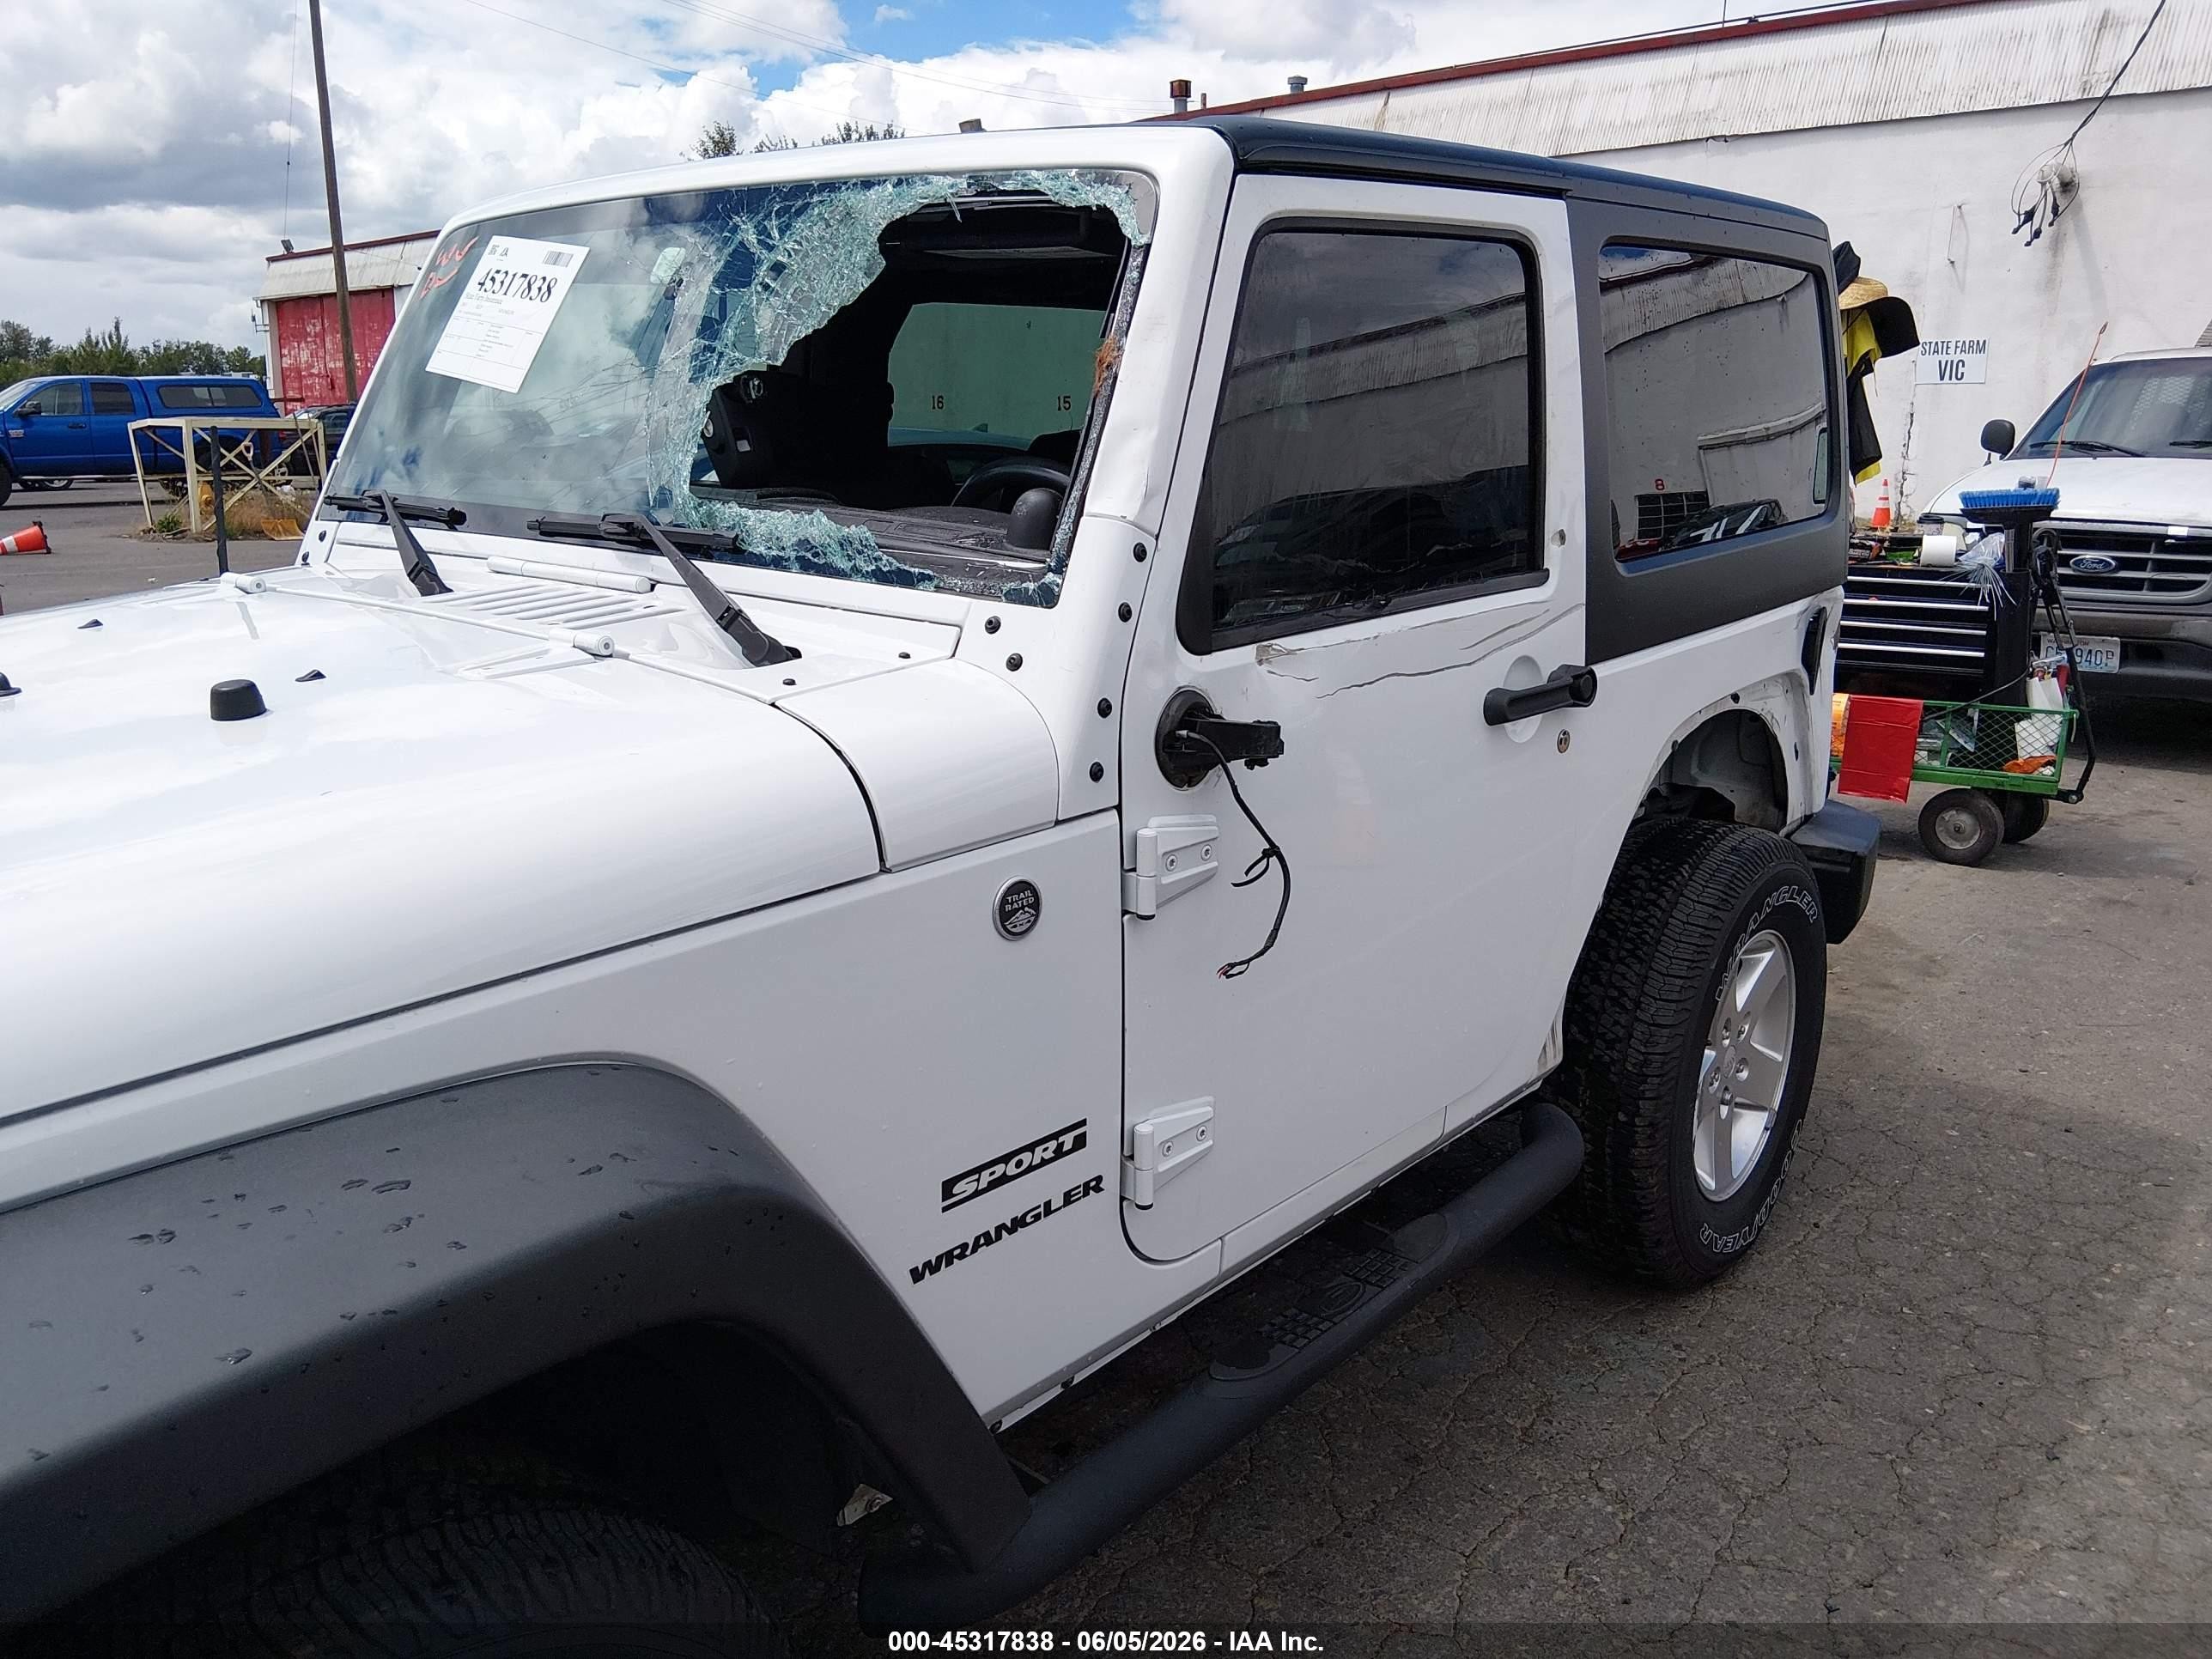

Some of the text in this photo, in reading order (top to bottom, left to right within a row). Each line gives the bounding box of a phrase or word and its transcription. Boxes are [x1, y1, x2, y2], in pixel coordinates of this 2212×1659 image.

[477, 268, 557, 302] 45317838
[1920, 339, 1986, 356] STATE FARM
[1938, 359, 1966, 381] VIC
[932, 396, 944, 410] 16
[1057, 396, 1071, 410] 15
[2079, 559, 2106, 570] Ford
[1005, 896, 1035, 912] RATED
[1006, 890, 1033, 903] TRAIL
[1716, 886, 1818, 1001] WRANGLER
[952, 1132, 1077, 1196] SPORT
[1699, 1119, 1802, 1253] GOODYEAR
[908, 1175, 1105, 1285] WRANGLER
